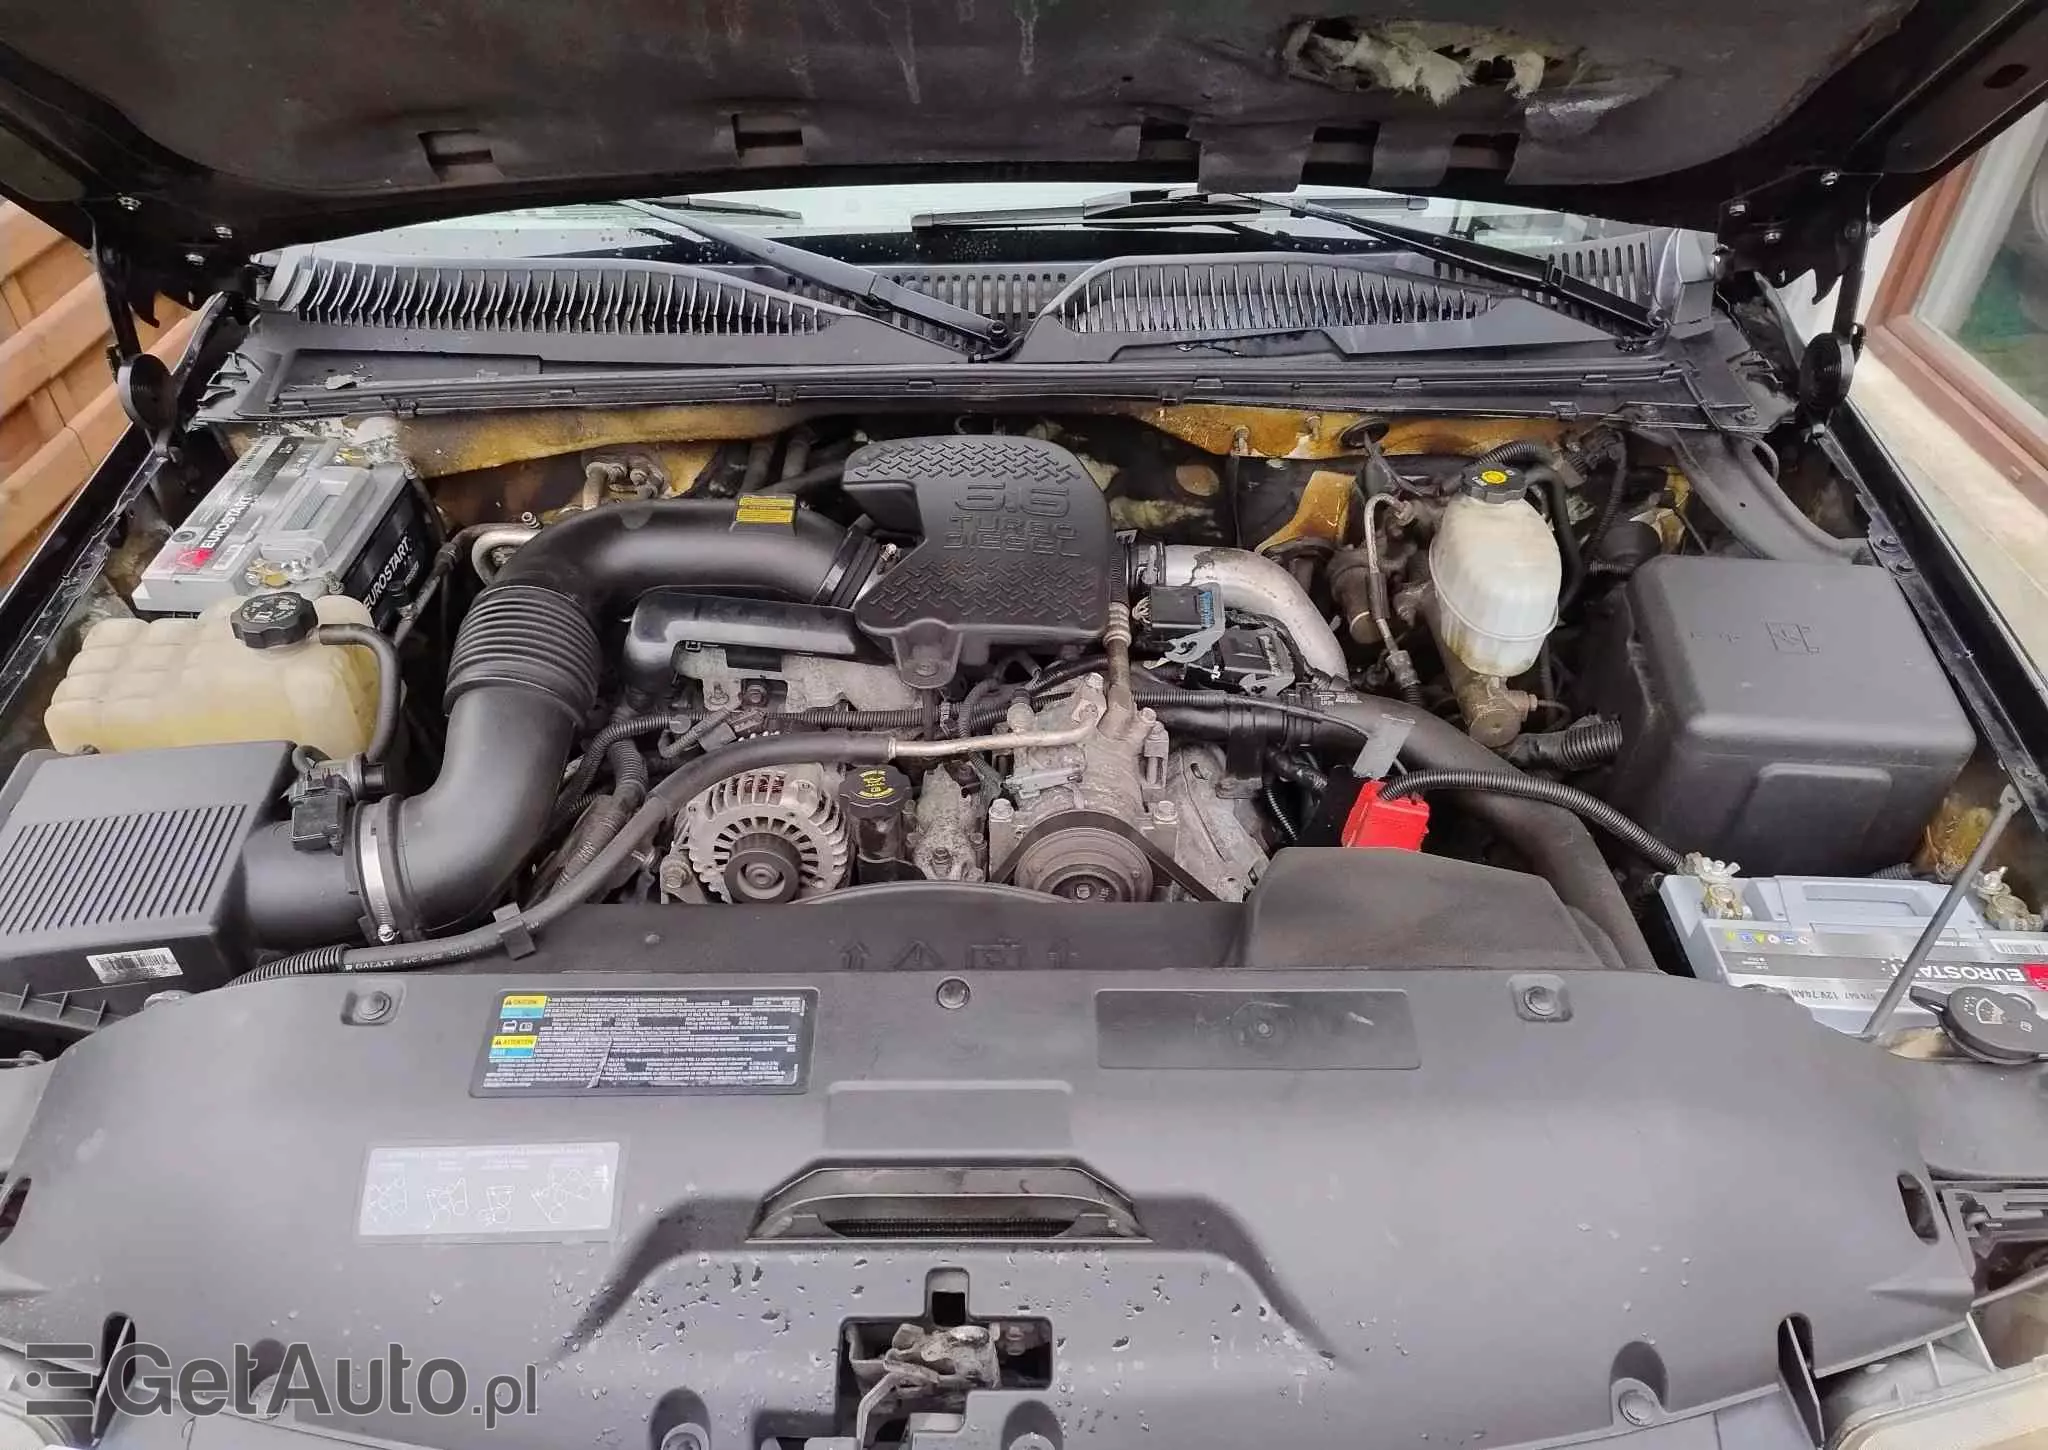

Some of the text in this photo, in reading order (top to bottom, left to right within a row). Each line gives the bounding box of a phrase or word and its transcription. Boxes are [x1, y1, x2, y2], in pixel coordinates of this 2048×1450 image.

[200, 495, 252, 549] EUROSTART
[950, 514, 1078, 541] TURBO
[943, 532, 1081, 557] DIESEL
[363, 536, 409, 612] EUROSTART
[1891, 963, 2027, 982] EUROSTAT
